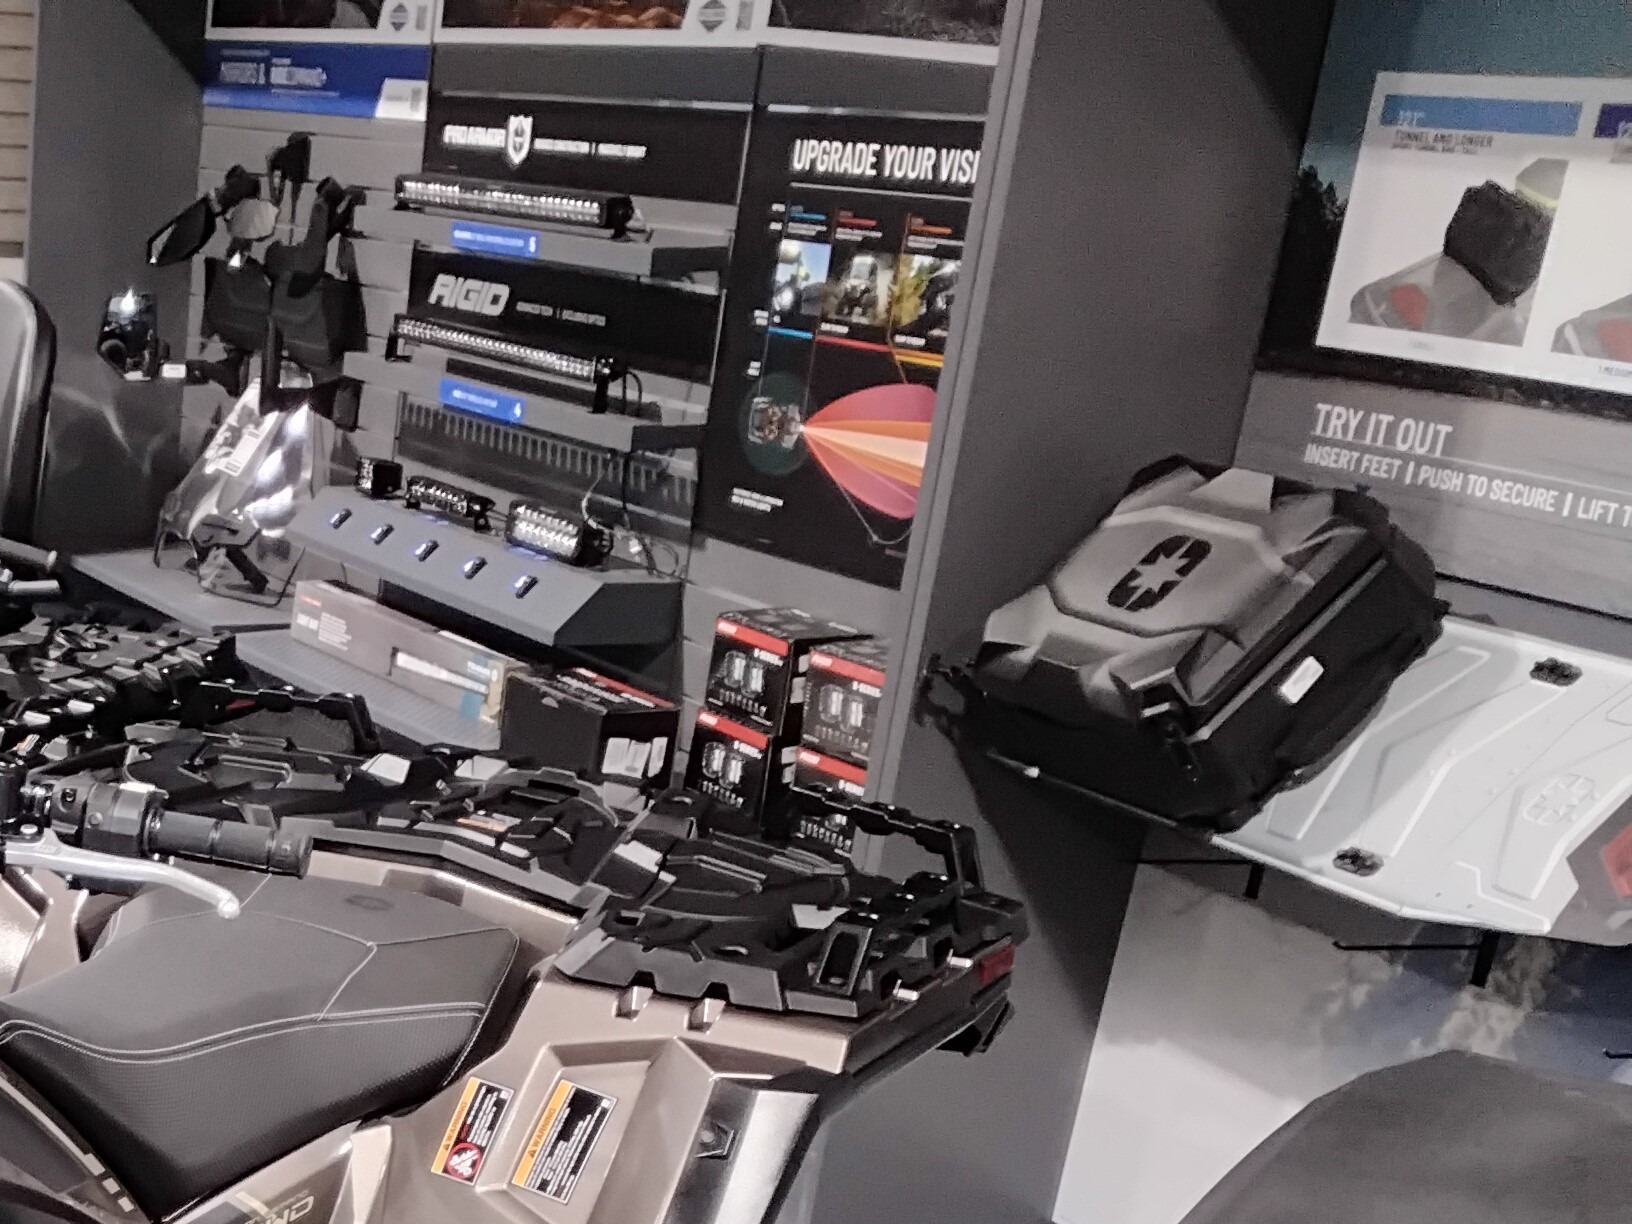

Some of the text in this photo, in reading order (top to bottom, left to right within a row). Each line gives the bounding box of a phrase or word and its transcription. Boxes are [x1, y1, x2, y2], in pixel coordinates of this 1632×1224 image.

[793, 138, 981, 184] UPGRADE YOUR VISI
[428, 273, 510, 317] RIGID
[1315, 403, 1453, 457] TRY IT OUT
[1305, 443, 1361, 472] INSERT
[1362, 453, 1402, 480] FEET
[1418, 464, 1462, 492] PUSH
[1466, 474, 1489, 498] TO
[1490, 479, 1560, 512] SECURE
[1577, 495, 1620, 525] LIFT
[534, 1107, 556, 1147] WARNING
